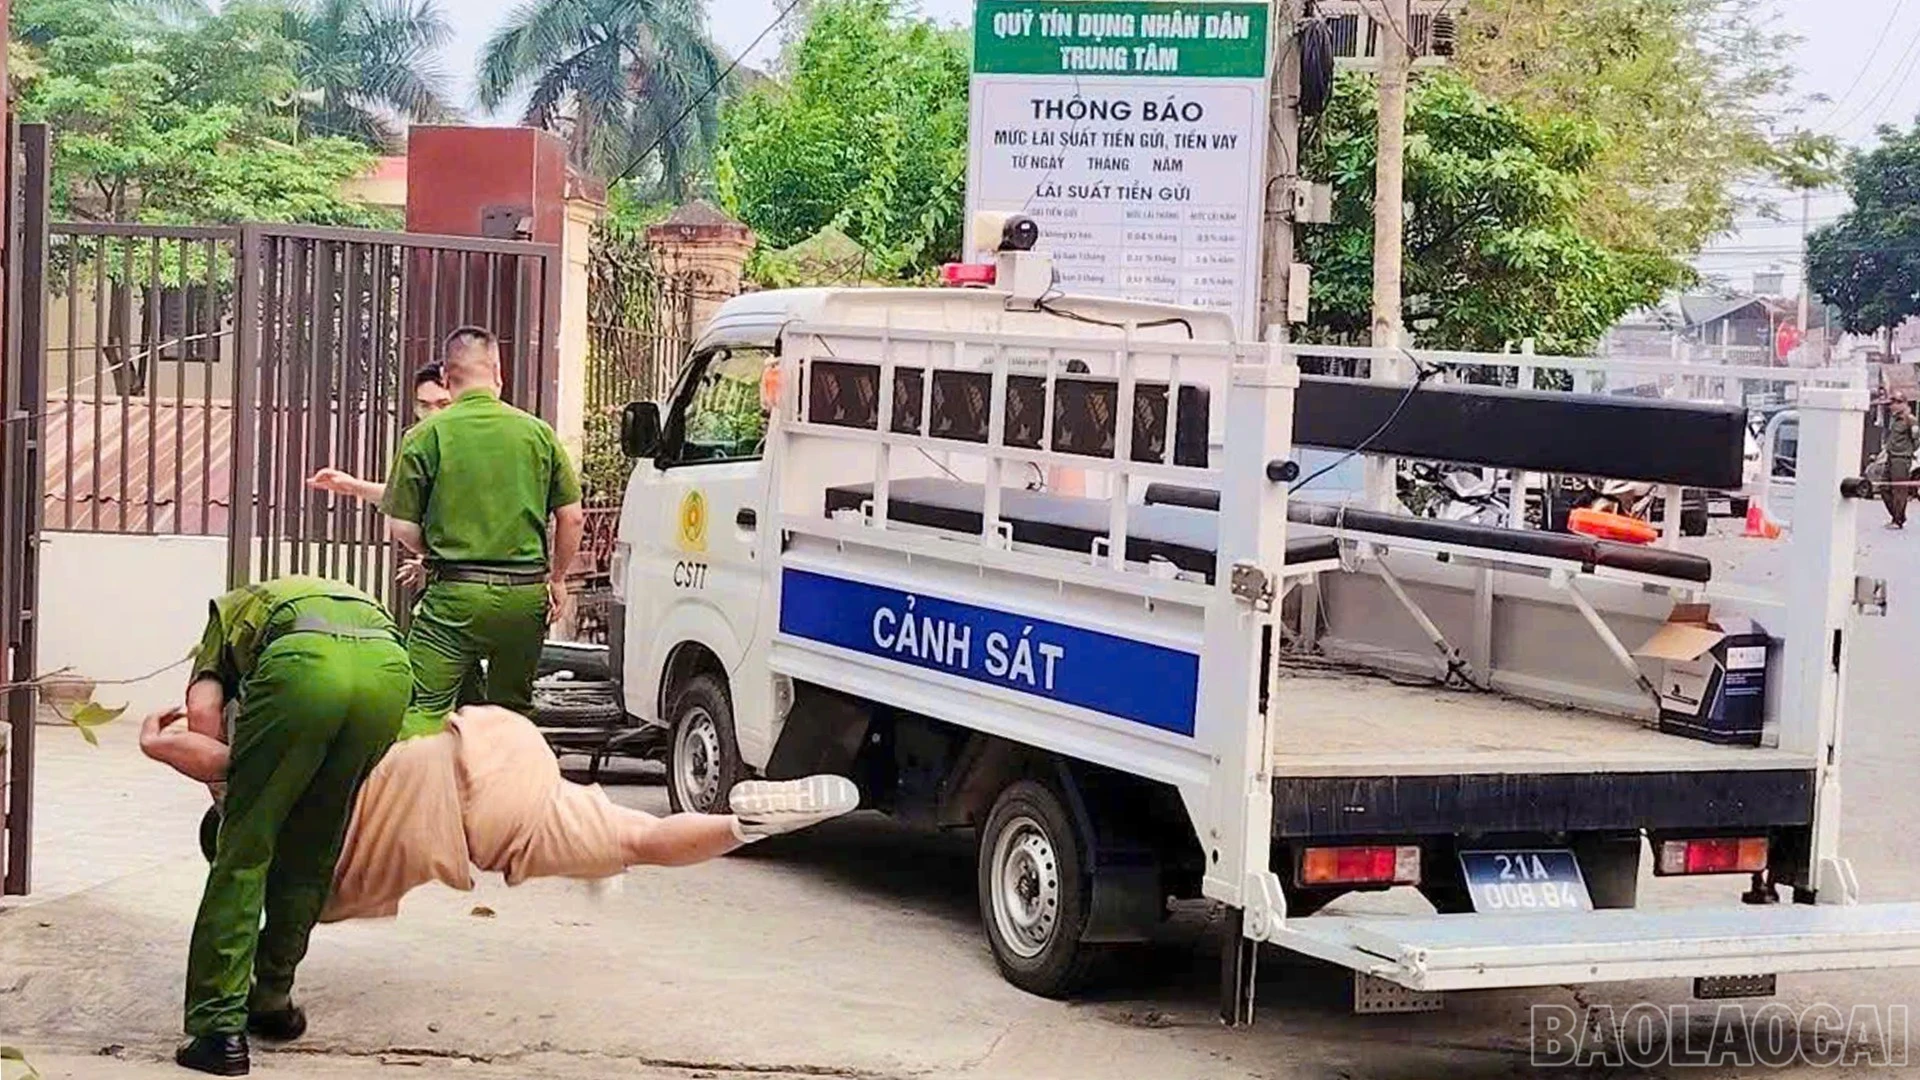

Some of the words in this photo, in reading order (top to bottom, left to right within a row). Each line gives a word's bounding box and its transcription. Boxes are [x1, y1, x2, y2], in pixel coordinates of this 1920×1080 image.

[994, 8, 1034, 38] QUỸ
[1040, 8, 1072, 36] TÍN
[1078, 13, 1135, 42] DỤNG
[1141, 10, 1199, 38] NHÂN
[1205, 11, 1249, 39] DÂN
[1060, 46, 1128, 70] TRUNG
[1133, 43, 1178, 71] TÂM
[1031, 94, 1132, 121] THÔNG
[1143, 95, 1203, 122] BÁO
[1060, 126, 1097, 147] SUẤT
[1212, 134, 1237, 149] VAY
[1153, 156, 1183, 172] NĂM
[1036, 182, 1062, 198] LÃI
[1068, 180, 1111, 200] SUẤT
[1158, 182, 1190, 201] GỬI
[674, 560, 708, 590] CSTT
[873, 595, 971, 669] CẢNH
[985, 625, 1064, 690] SÁT
[1495, 854, 1549, 880] 21A
